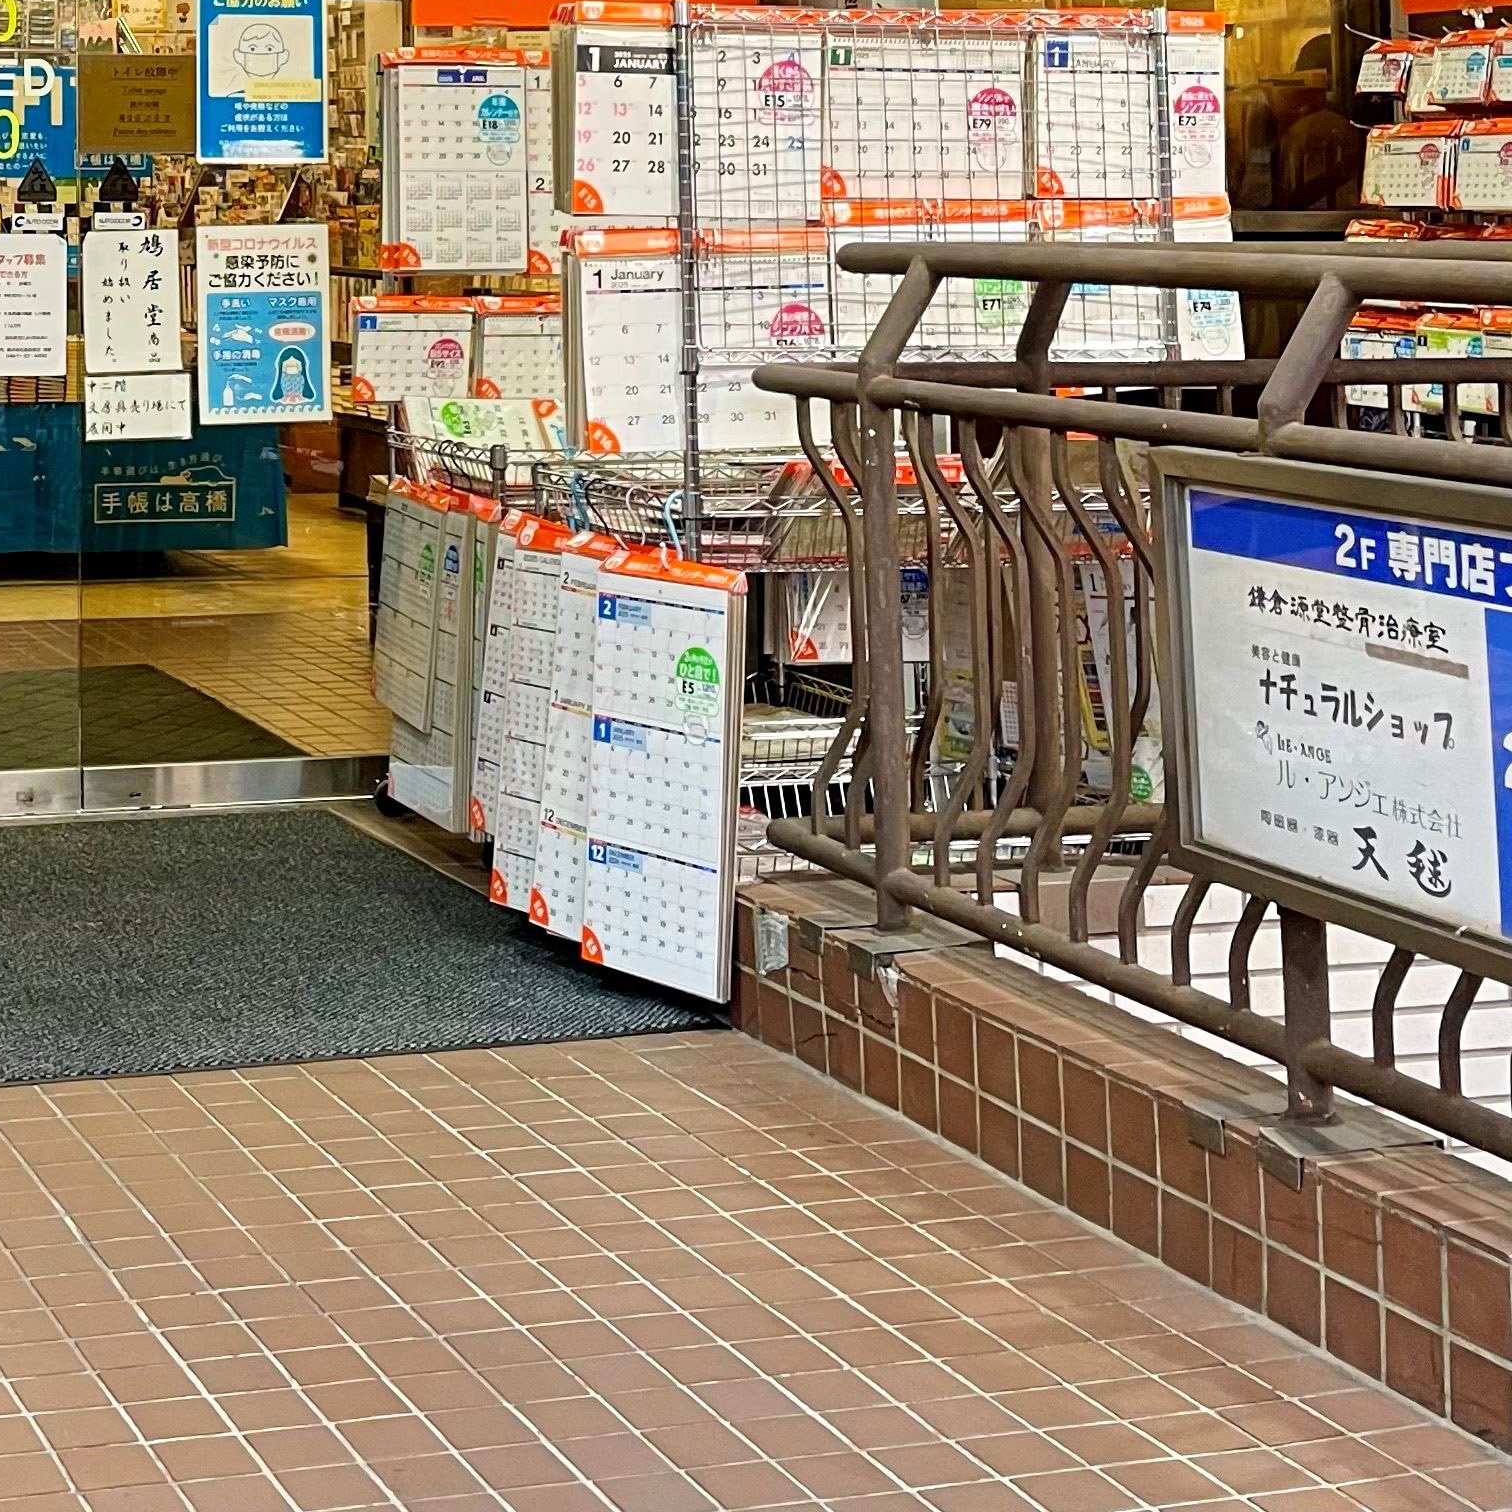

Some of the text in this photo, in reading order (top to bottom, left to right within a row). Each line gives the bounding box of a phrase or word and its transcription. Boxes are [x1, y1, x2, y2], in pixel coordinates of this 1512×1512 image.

[588, 46, 601, 72] 1
[613, 58, 668, 70] JANUARY
[752, 51, 761, 65] 3
[613, 75, 623, 89] 6
[649, 76, 658, 89] 7
[763, 94, 786, 108] E15
[576, 102, 593, 116] 12
[612, 102, 629, 117] 13
[647, 104, 664, 118] 14
[482, 120, 499, 130] E18
[972, 118, 992, 130] E79
[1178, 115, 1198, 127] E73
[576, 129, 593, 144] 19
[612, 131, 631, 146] 20
[647, 132, 664, 146] 21
[752, 135, 770, 148] 24
[576, 157, 596, 172] 26
[612, 159, 631, 174] 27
[647, 160, 666, 175] 28
[752, 163, 768, 176] 31
[535, 177, 546, 191] 2
[206, 237, 318, 252] 新型コロナウイルス
[225, 254, 301, 270] 感染予防に
[591, 267, 665, 289] 1 January
[982, 298, 1002, 311] E71
[657, 353, 671, 365] 14
[625, 381, 743, 396] 20 21 23
[627, 410, 778, 427] 27 28 30 31
[101, 490, 228, 516] 手帳は高橋
[1334, 522, 1377, 571] 2F
[602, 600, 613, 616] 2
[1257, 668, 1456, 751] ナチュラルショップ
[590, 844, 606, 862] 12
